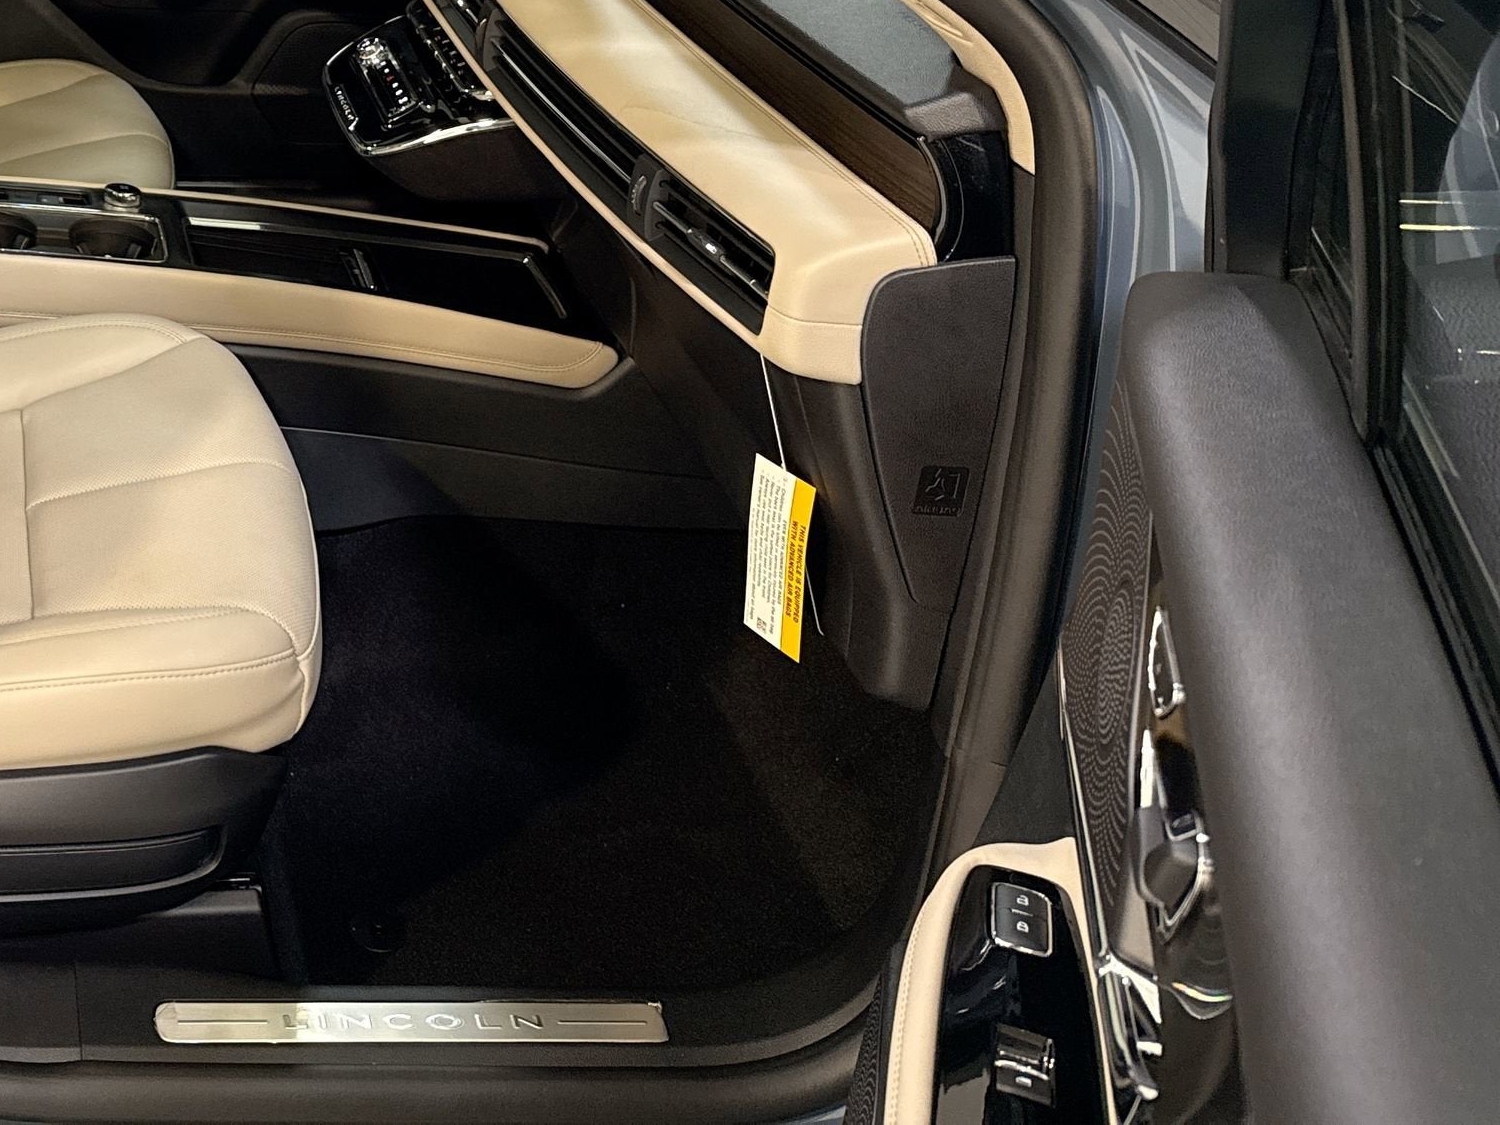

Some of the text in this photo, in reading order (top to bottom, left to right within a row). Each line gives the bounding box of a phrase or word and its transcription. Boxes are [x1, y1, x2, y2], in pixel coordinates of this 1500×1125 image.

[790, 519, 798, 542] WITH
[798, 524, 806, 544] THIS
[786, 540, 796, 582] ADVANCED
[795, 543, 804, 576] VEHICLE
[784, 595, 792, 618] BAGS
[791, 584, 801, 624] EQUIPPED
[283, 1013, 543, 1030] LINCOLN
